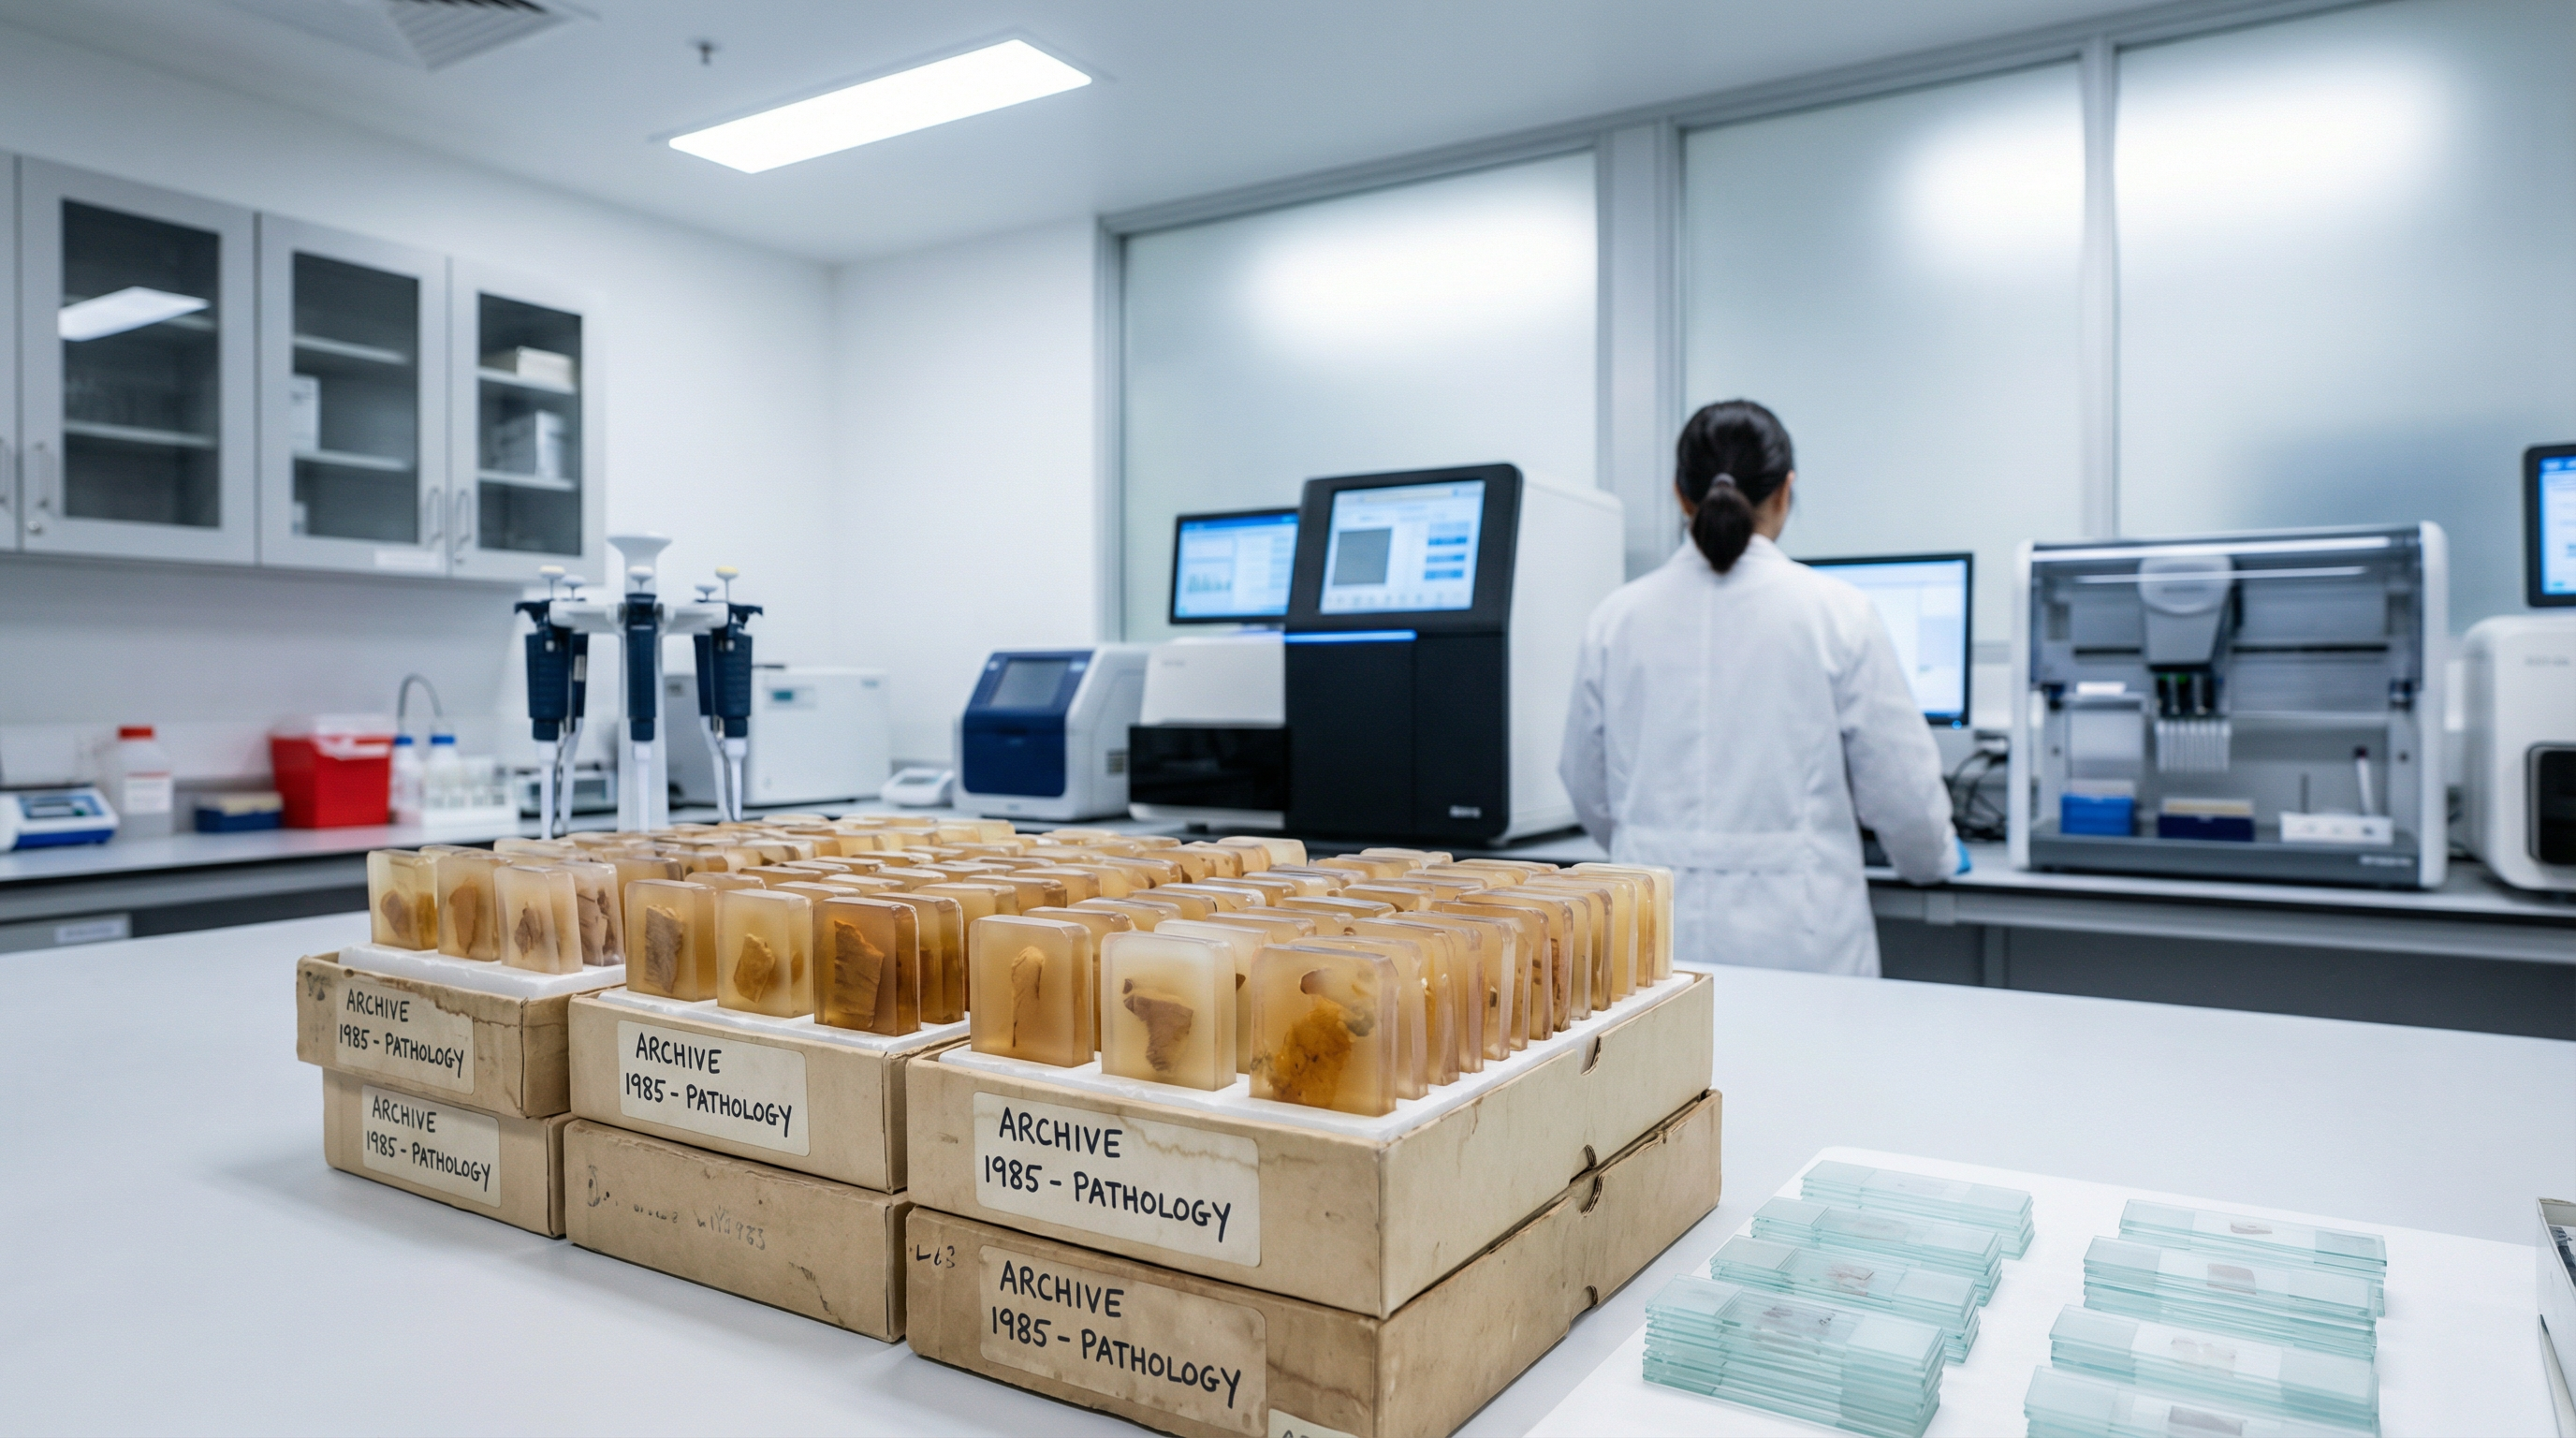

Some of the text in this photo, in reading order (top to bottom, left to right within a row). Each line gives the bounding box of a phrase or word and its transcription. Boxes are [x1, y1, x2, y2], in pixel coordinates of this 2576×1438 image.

[346, 989, 410, 1022] ARCHIVE
[340, 1023, 371, 1050] 1985
[385, 1032, 464, 1078] PATHOLOGY
[636, 1032, 722, 1075] ARCHIVE
[373, 1094, 437, 1133] ARCHIVE
[625, 1072, 666, 1103] 1985
[686, 1083, 792, 1138] PATHOLOGY
[999, 1107, 1123, 1158] ARCHIVE
[367, 1131, 398, 1158] 1985
[411, 1141, 490, 1193] PATHOLOGY
[985, 1154, 1043, 1193] 1985
[1073, 1171, 1231, 1243] PATHOLOGY
[1000, 1259, 1125, 1318] ARCHIVE
[991, 1306, 1052, 1348] 1985
[1081, 1328, 1241, 1410] PATHOLOGY
